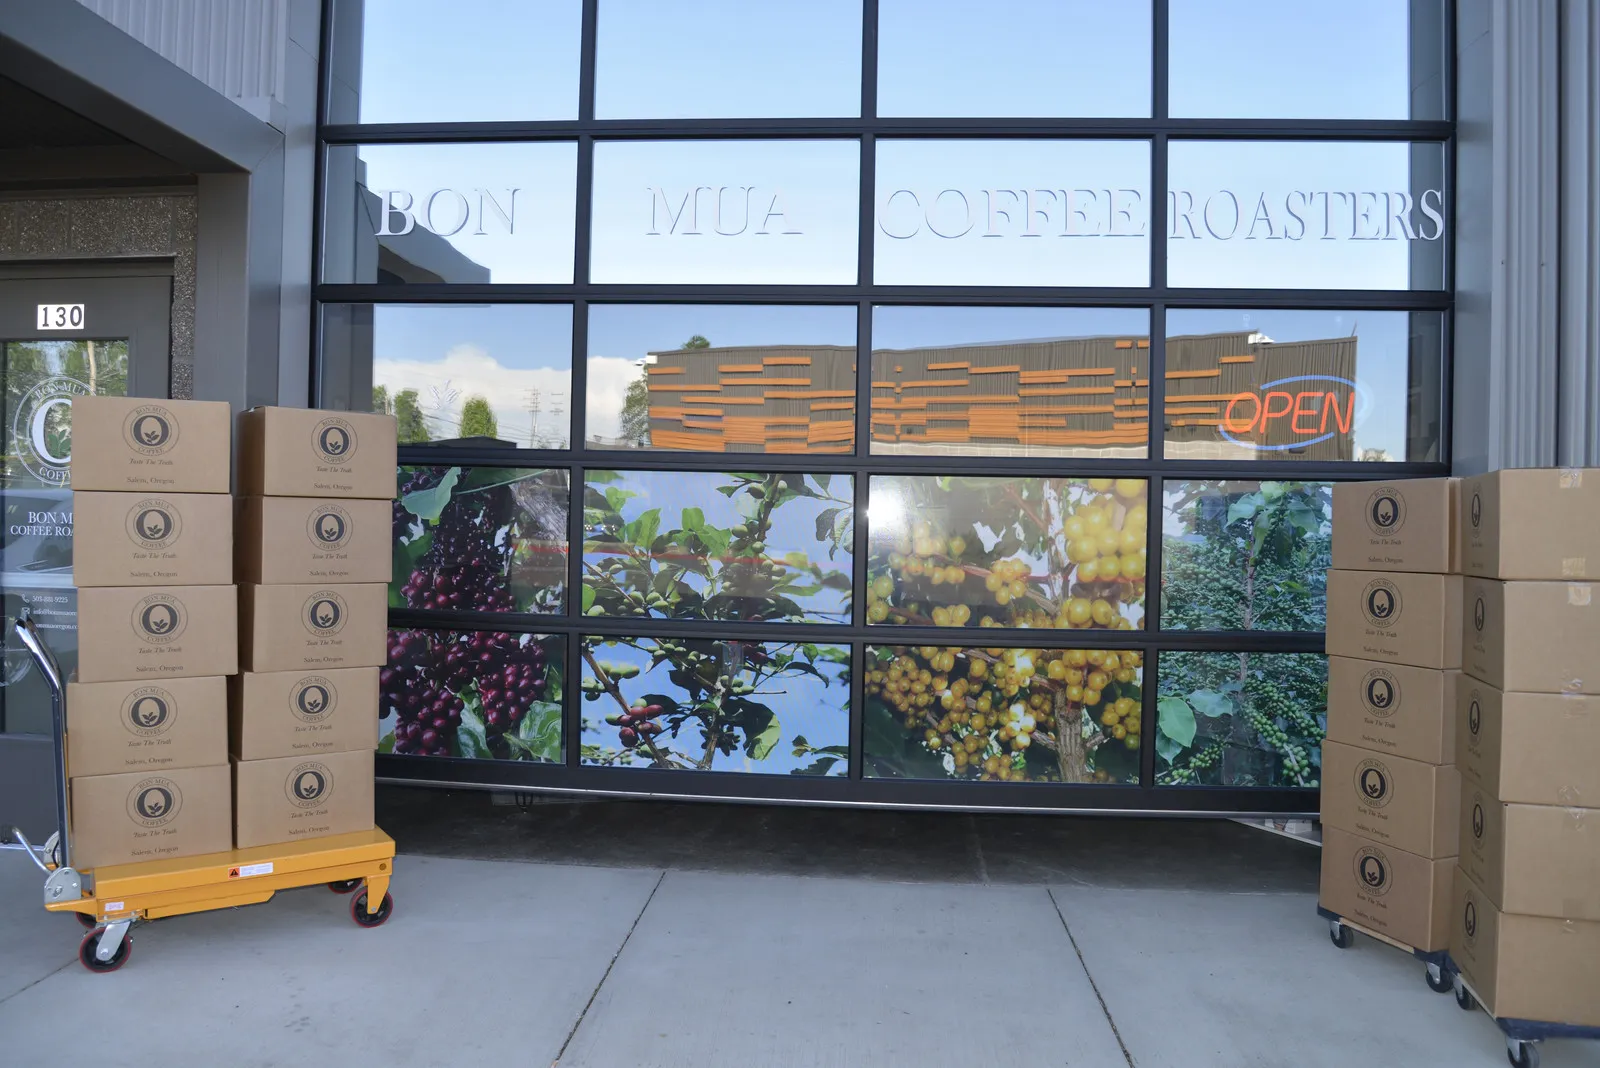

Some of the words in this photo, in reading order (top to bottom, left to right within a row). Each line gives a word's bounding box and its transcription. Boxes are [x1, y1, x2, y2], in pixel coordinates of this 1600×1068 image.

[375, 187, 521, 237] BON
[645, 185, 804, 237] MUA
[877, 188, 1146, 240] COFFEE
[1167, 188, 1444, 243] ROASTERS
[42, 305, 83, 328] 130
[1224, 391, 1355, 434] OPEN
[28, 511, 57, 524] BON
[10, 525, 52, 536] COFFEE
